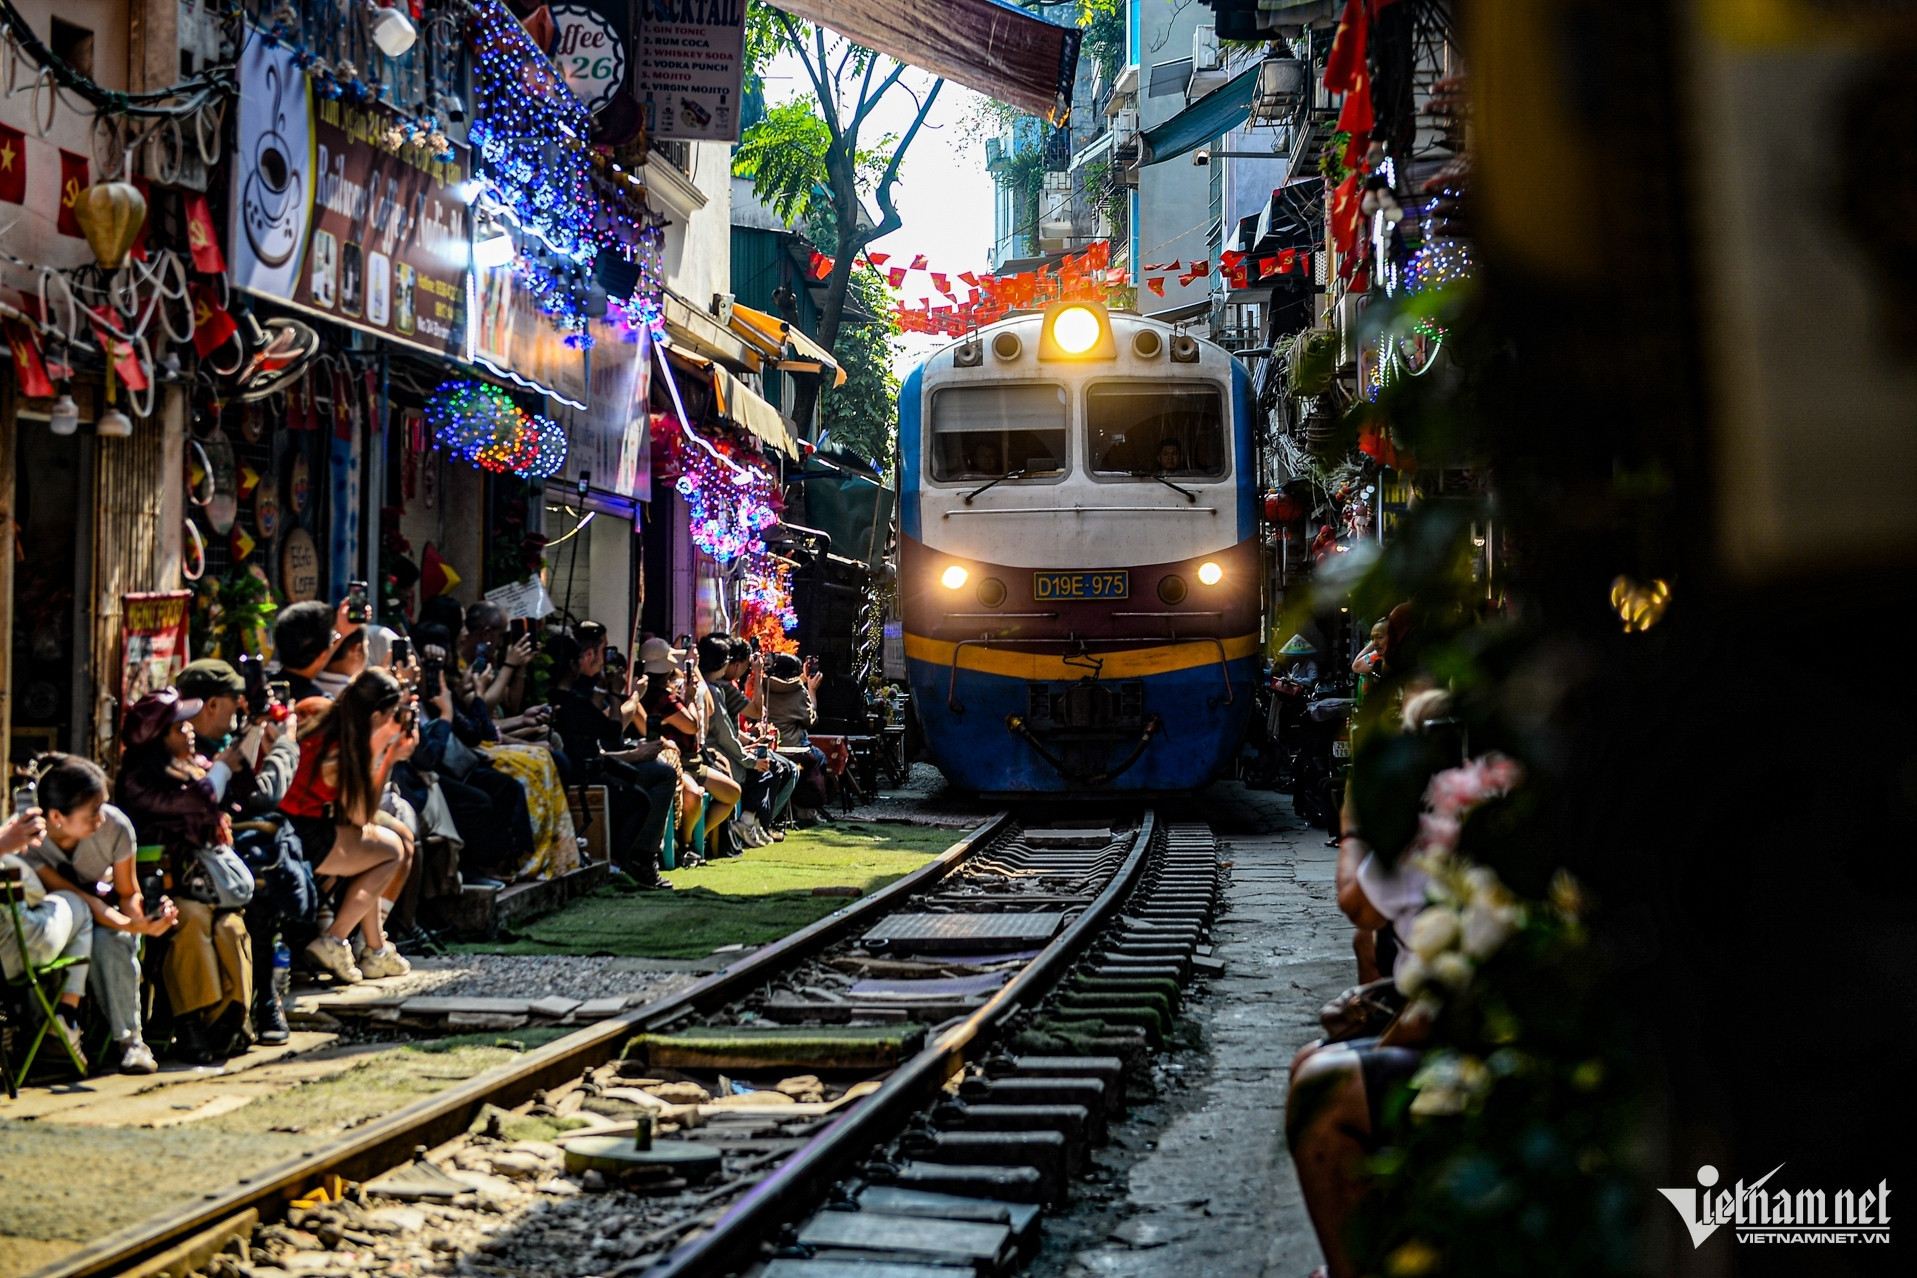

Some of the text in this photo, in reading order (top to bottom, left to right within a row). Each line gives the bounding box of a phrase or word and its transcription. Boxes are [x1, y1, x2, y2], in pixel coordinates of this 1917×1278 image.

[642, 0, 740, 27] COCKTAIL
[653, 26, 674, 34] GIN
[675, 26, 706, 36] TONIC
[557, 23, 606, 55] ffee
[644, 37, 710, 48] 2. RUM COCA
[654, 49, 703, 59] WHISKEY
[705, 52, 734, 60] SODA
[569, 56, 612, 80] 26
[642, 60, 728, 72] 4. VODKA PUNCH
[652, 72, 691, 81] MOJITO
[640, 82, 730, 95] 6. VIRGIN MOJITO
[316, 144, 367, 242] Railway
[370, 170, 407, 256] Coffee
